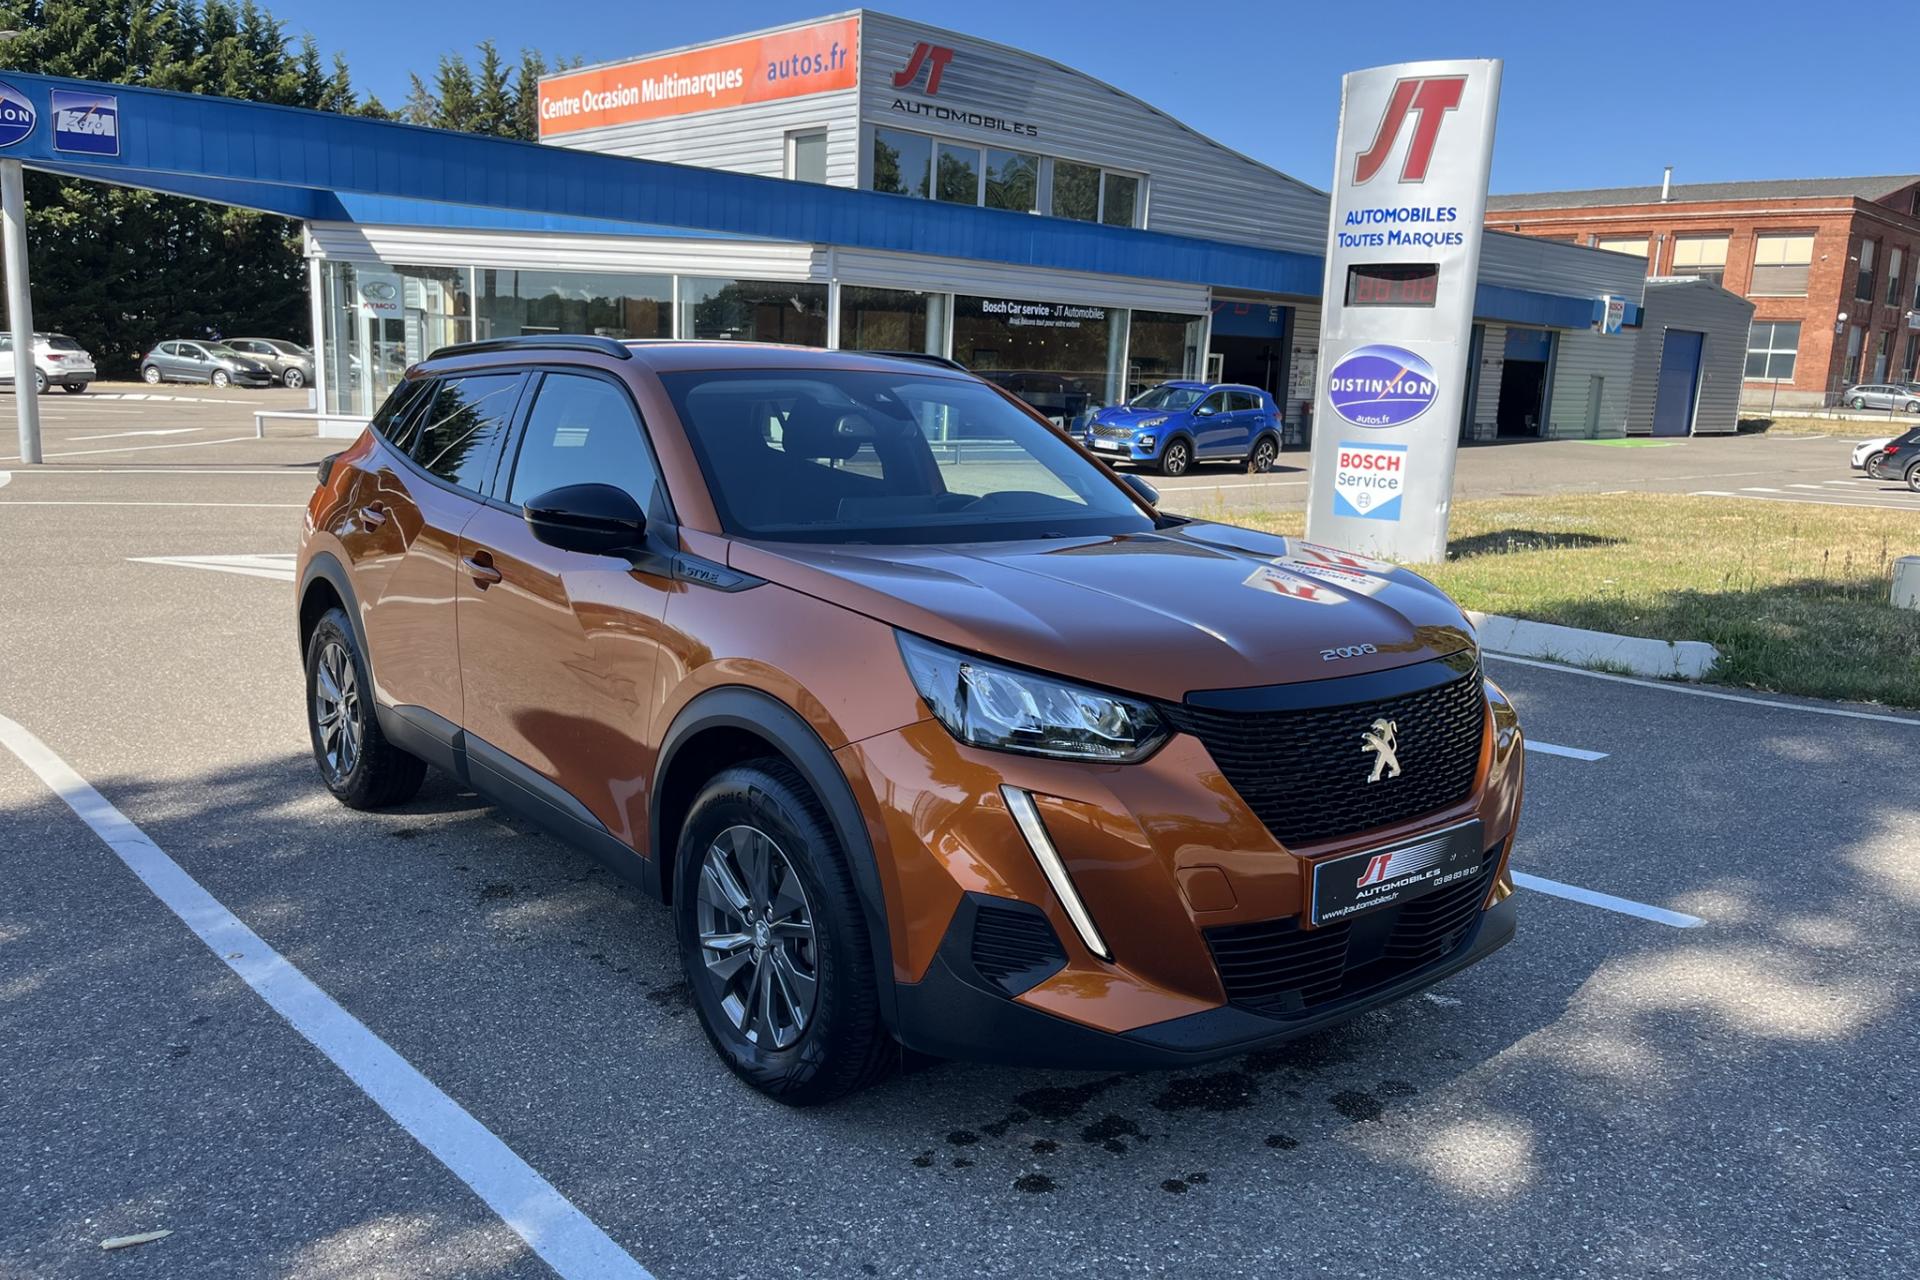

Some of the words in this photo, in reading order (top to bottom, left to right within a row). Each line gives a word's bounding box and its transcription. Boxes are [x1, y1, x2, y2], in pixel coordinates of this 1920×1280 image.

[767, 42, 847, 82] autos.fr
[891, 41, 954, 97] JT
[541, 95, 580, 120] Centre
[582, 83, 639, 113] Occasion
[641, 67, 743, 102] Multimarques
[891, 99, 1038, 137] AUTOMOBILES
[1351, 74, 1469, 187] JT
[1345, 207, 1457, 226] AUTOMOBILES
[363, 302, 397, 310] KYMCO
[982, 300, 1006, 313] Bosch
[1008, 302, 1021, 314] Car
[1022, 304, 1049, 316] service
[1054, 305, 1063, 316] JT
[1064, 306, 1104, 320] Automobiles
[1331, 378, 1432, 395] DISTINXION
[1356, 414, 1390, 425] autos.fr
[1340, 453, 1400, 471] BOSCH
[1338, 472, 1398, 490] Service
[687, 567, 719, 583] STYLE
[1319, 643, 1377, 661] 2008
[1357, 852, 1392, 888] JT
[1433, 877, 1443, 886] 03
[1470, 865, 1479, 874] 07
[1356, 868, 1441, 899] AUTOMOBILES
